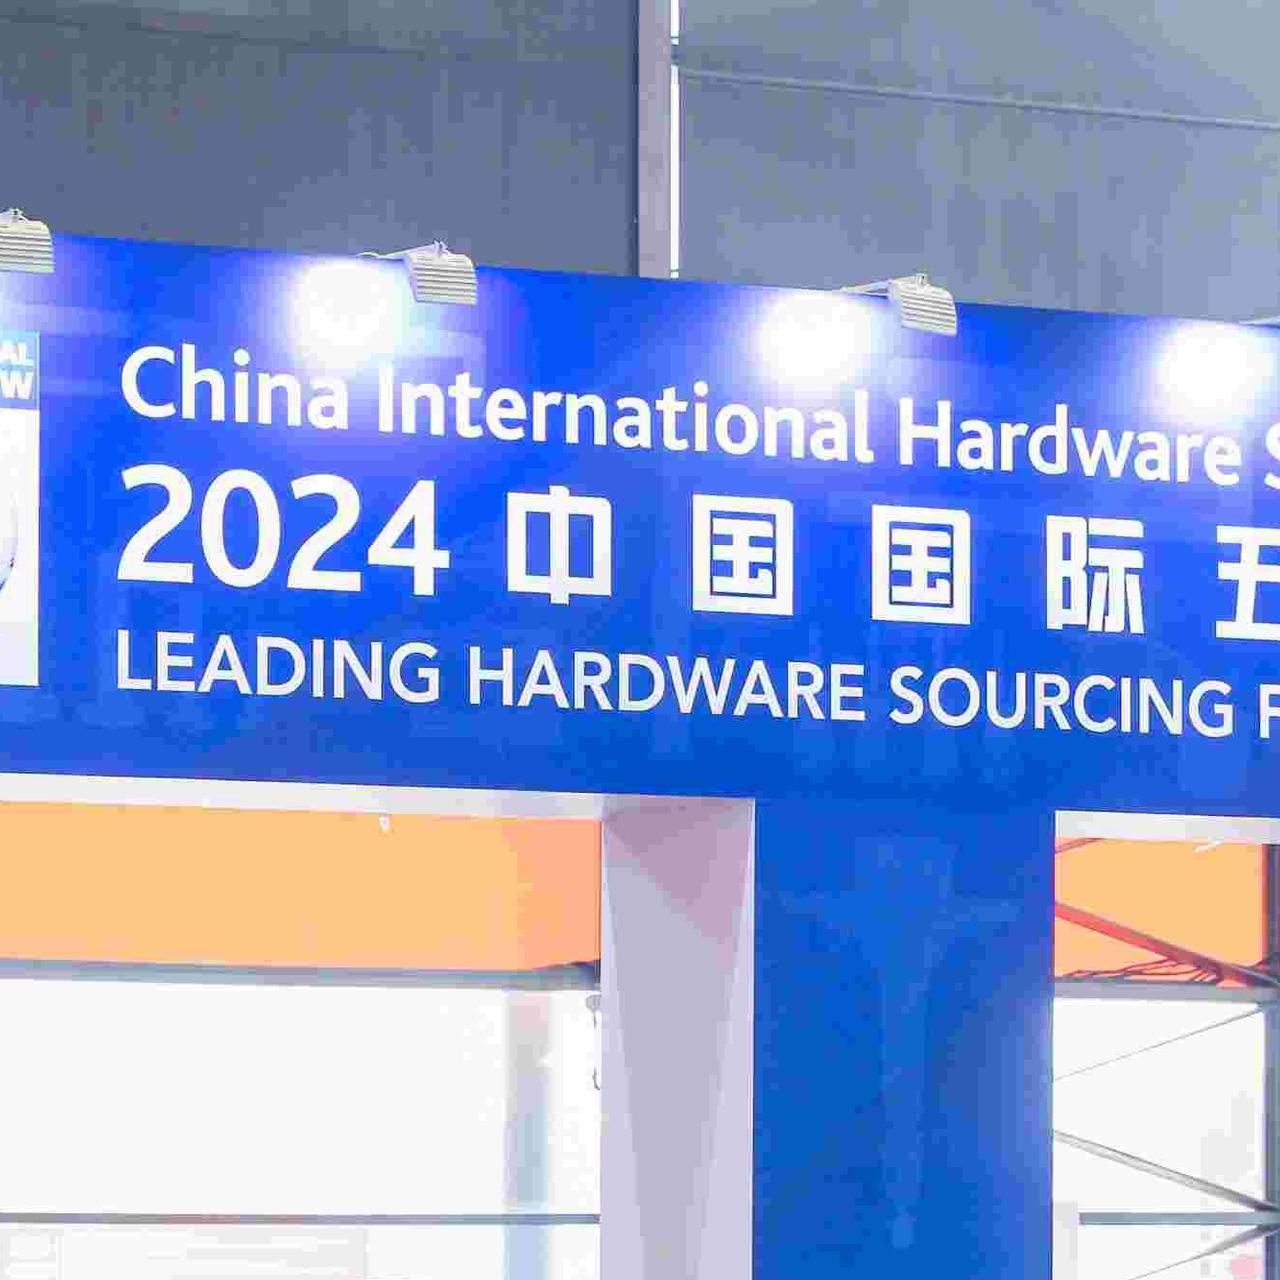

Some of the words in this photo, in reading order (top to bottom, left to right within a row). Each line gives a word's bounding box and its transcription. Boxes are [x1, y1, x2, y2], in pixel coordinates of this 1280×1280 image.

[119, 342, 350, 432] China
[377, 363, 875, 463] International
[898, 396, 1242, 487] Hardware
[117, 463, 450, 597] 2024
[117, 628, 440, 704] LEADING
[469, 646, 866, 722] HARDWARE
[889, 666, 1234, 739] SOURCING
